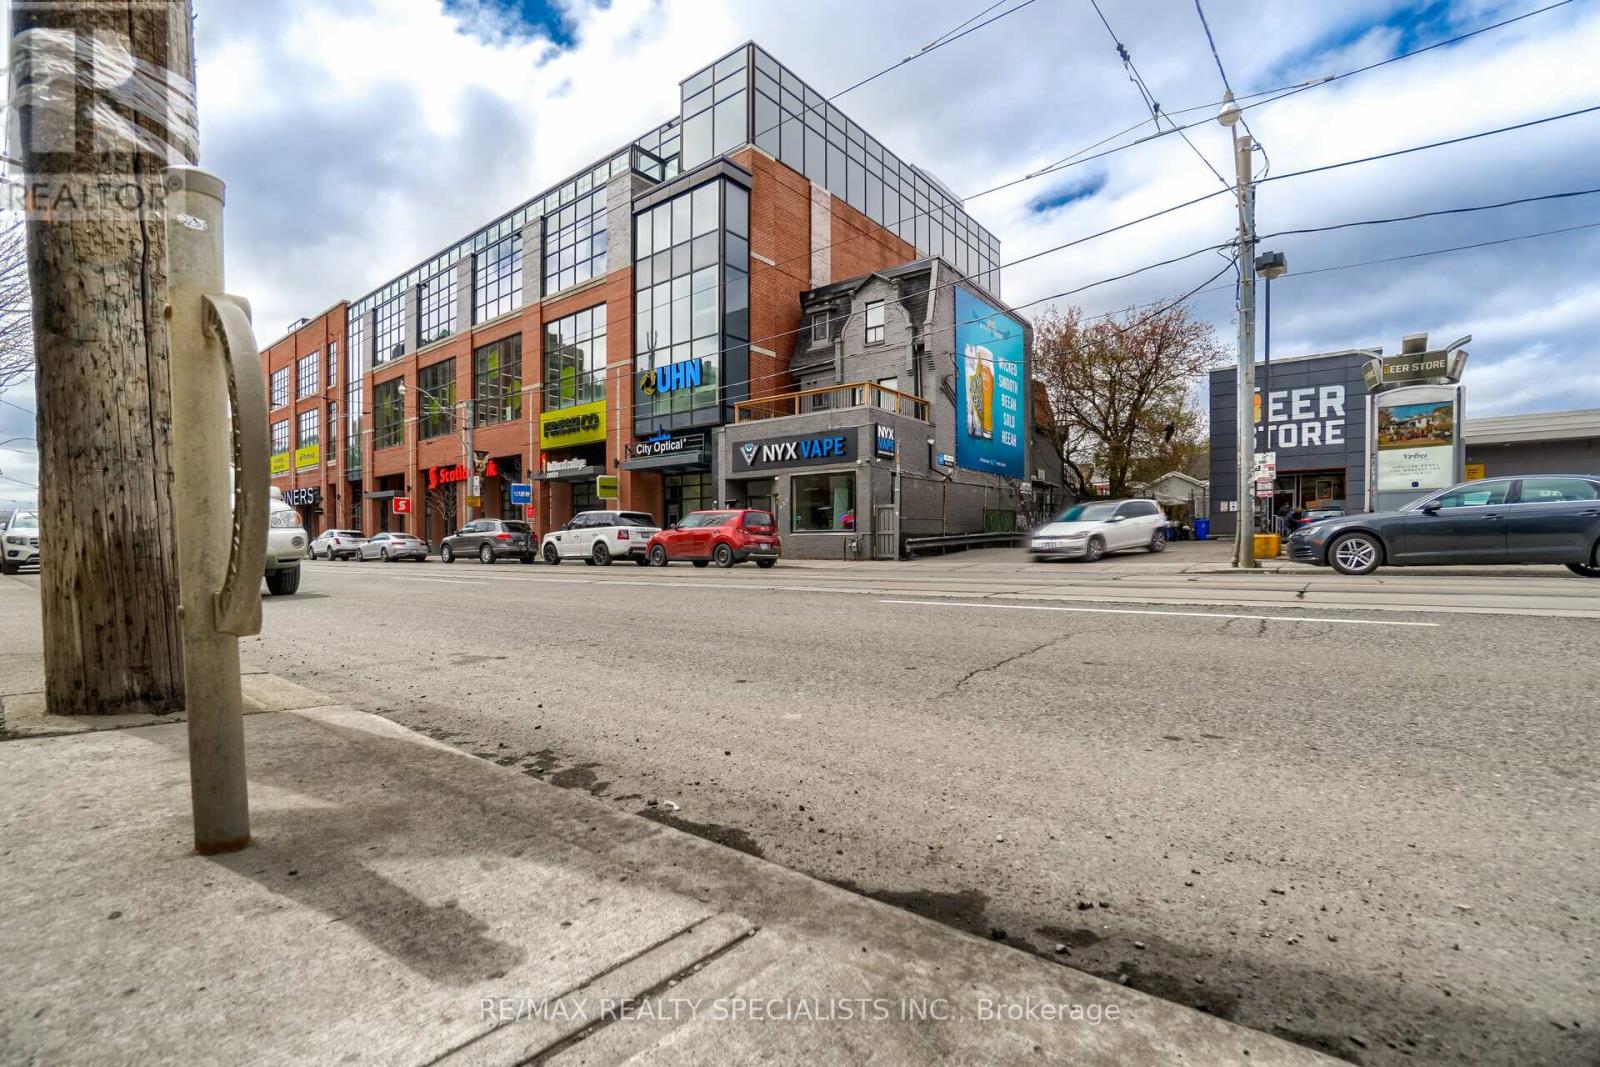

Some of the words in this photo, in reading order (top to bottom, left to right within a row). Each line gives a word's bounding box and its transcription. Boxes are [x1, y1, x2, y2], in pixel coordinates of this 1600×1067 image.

[1412, 359, 1446, 371] STORE
[656, 358, 702, 393] UHN
[877, 425, 894, 440] NYX
[1254, 419, 1345, 449] TORE
[636, 443, 652, 456] City
[653, 438, 683, 454] Optical
[763, 441, 798, 462] NYX
[801, 436, 845, 458] VAPE
[878, 437, 895, 451] VAPE
